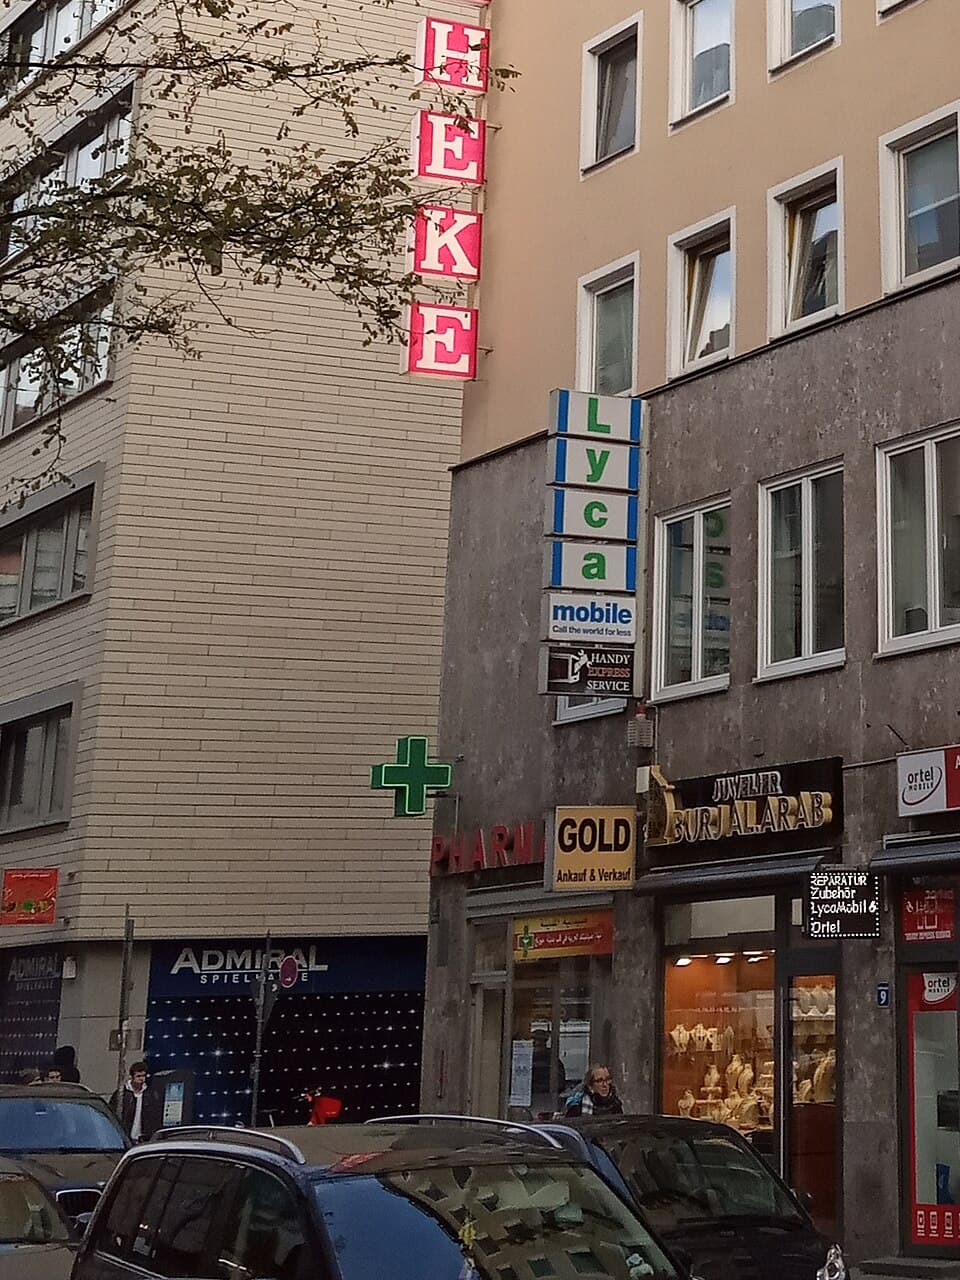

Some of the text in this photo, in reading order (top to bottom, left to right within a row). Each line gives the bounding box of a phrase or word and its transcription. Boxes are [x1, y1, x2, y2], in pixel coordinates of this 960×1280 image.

[581, 397, 611, 580] Lyca
[552, 601, 633, 624] mobile
[552, 625, 632, 637] Call the world for less
[591, 653, 631, 664] HANDY
[587, 666, 631, 678] EXPRESS
[586, 680, 630, 691] SERVICE
[907, 767, 934, 784] ortel
[557, 817, 632, 853] GOLD
[430, 820, 545, 874] PHARM
[556, 868, 632, 883] Ankauf & Verkauf
[810, 875, 867, 886] REPARATUR
[810, 886, 857, 899] Zubehör
[810, 919, 841, 934] Ortel
[170, 945, 329, 975] ADMIRAL
[199, 973, 309, 985] SPIELAE
[927, 976, 950, 989] ortel
[879, 990, 887, 1004] 9
